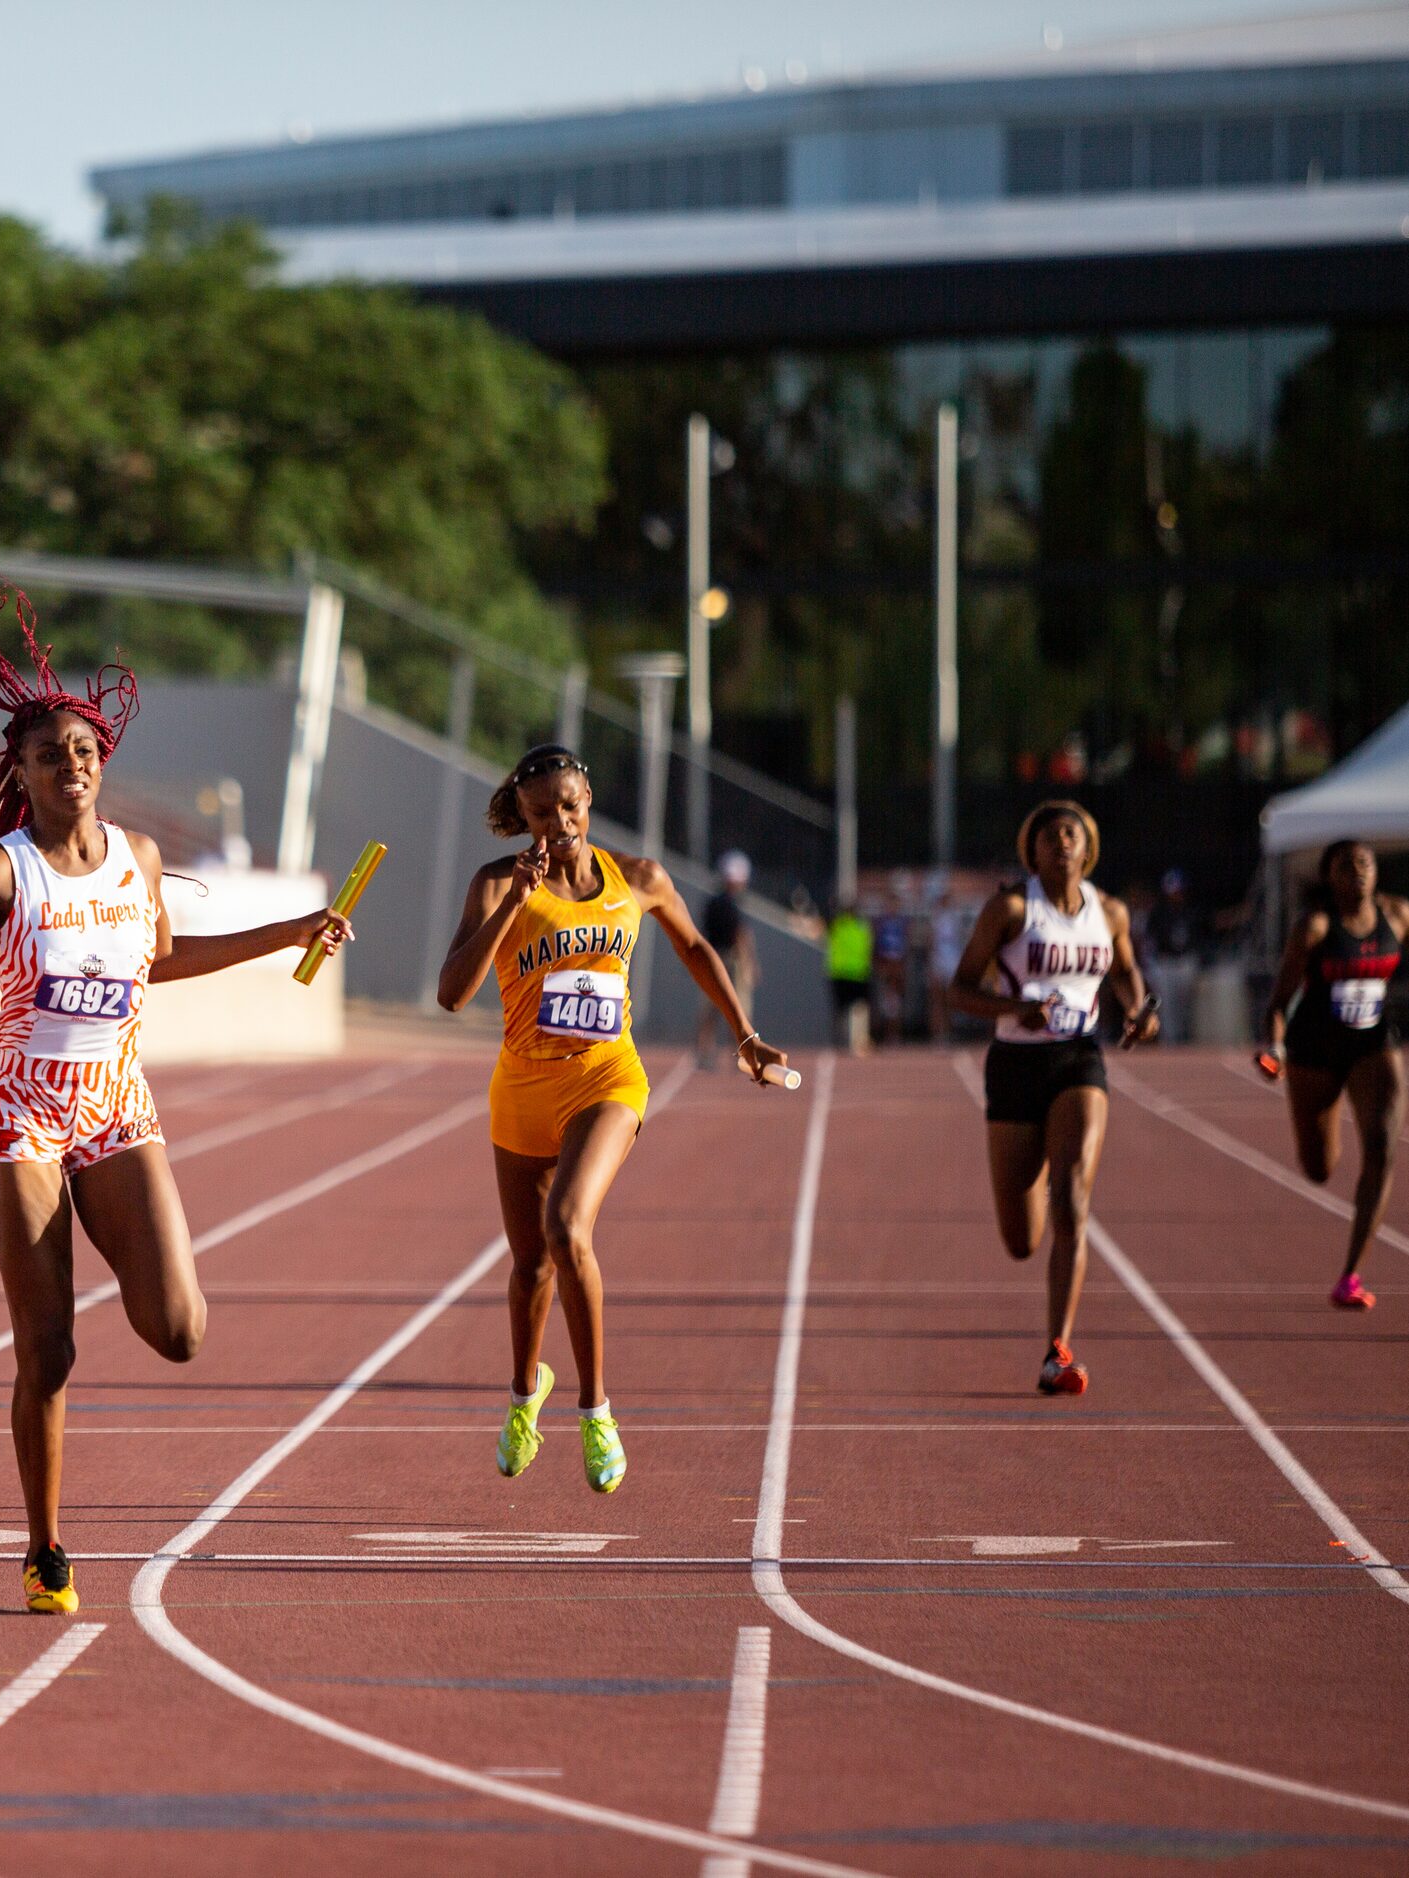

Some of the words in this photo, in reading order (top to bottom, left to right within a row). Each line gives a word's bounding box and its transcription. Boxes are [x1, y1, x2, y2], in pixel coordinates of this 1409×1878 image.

[38, 901, 86, 934] Lady
[89, 899, 140, 930] Tigers
[48, 980, 125, 1015] 1692
[549, 995, 616, 1031] 1409
